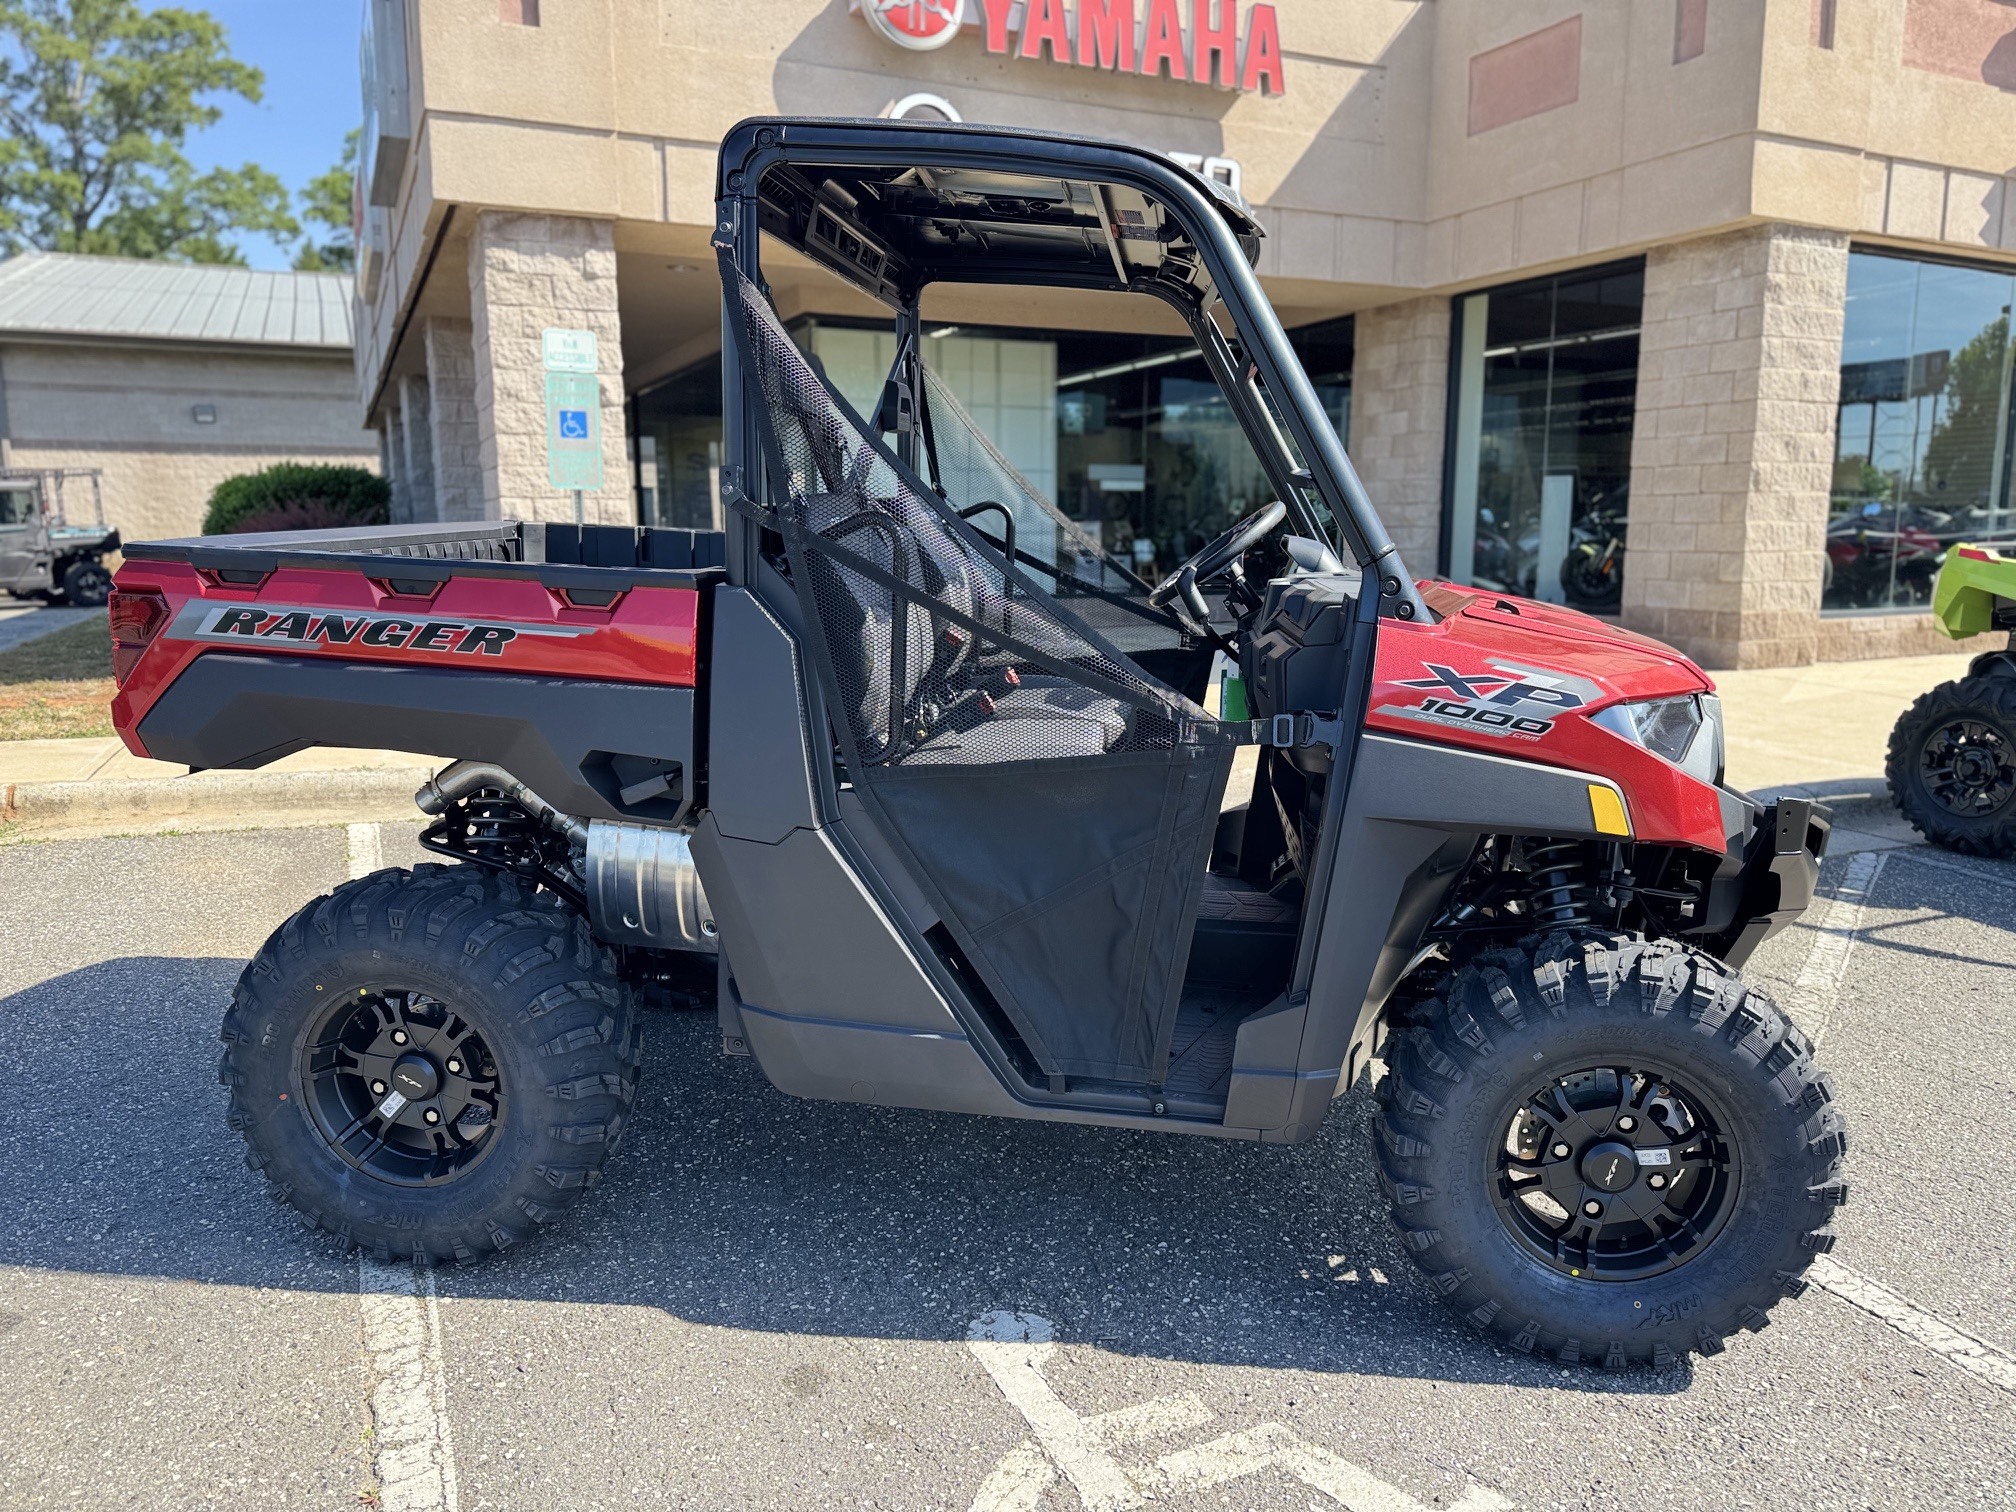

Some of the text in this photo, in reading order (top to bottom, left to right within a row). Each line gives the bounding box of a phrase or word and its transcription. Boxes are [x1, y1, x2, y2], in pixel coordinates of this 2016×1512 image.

[980, 0, 1285, 96] YAMAHA
[210, 606, 518, 656] RANGER
[1385, 661, 1586, 709] XP
[1414, 713, 1542, 743] DUAL OVERHEAD CAM
[1418, 697, 1555, 735] 1000
[259, 1021, 281, 1061] PRO
[397, 1074, 423, 1088] XP
[1450, 1087, 1497, 1209] PRO ARMOR
[449, 1128, 533, 1225] X-TERRAIN
[1604, 1158, 1619, 1187] XP
[1722, 1152, 1794, 1290] X-TERRAIN
